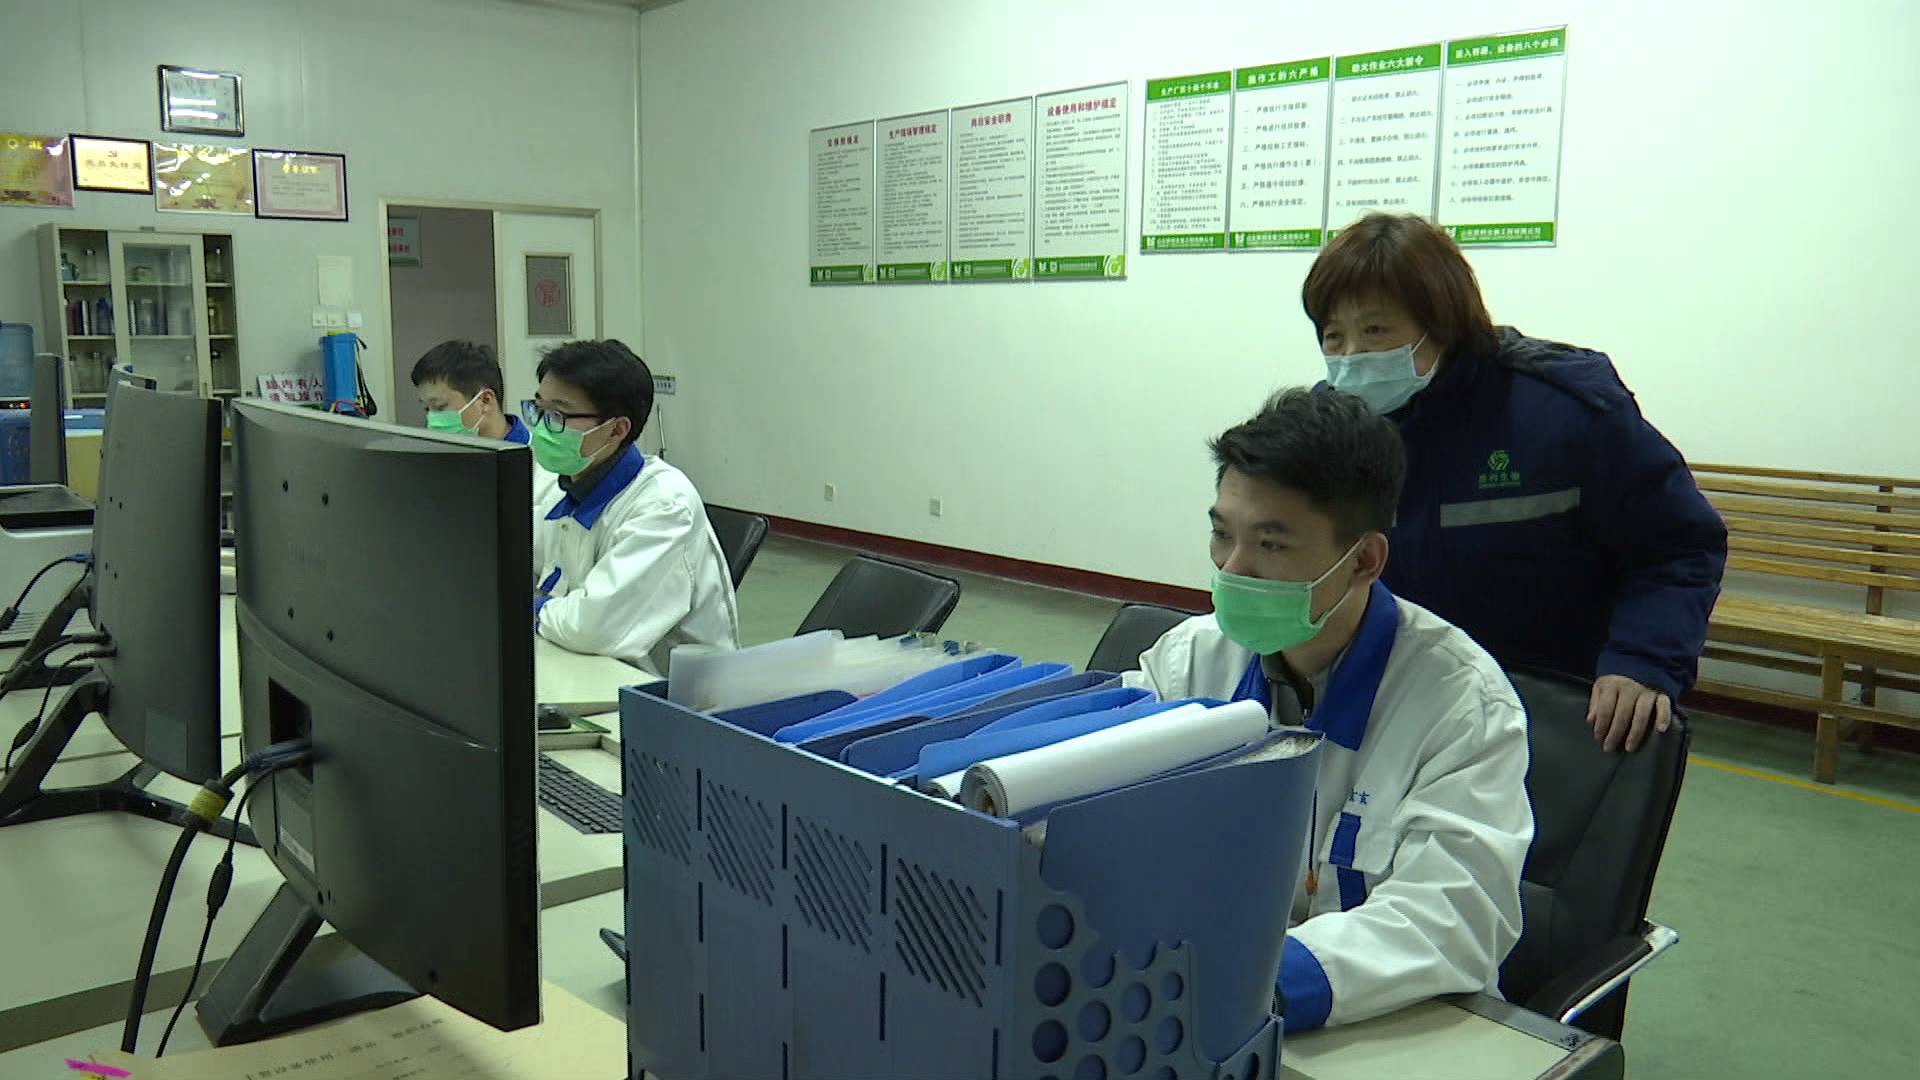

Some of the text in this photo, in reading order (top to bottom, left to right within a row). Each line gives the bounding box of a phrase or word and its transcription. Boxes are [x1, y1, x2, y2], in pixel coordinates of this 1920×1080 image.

[1247, 66, 1319, 85] 操作工的六严格
